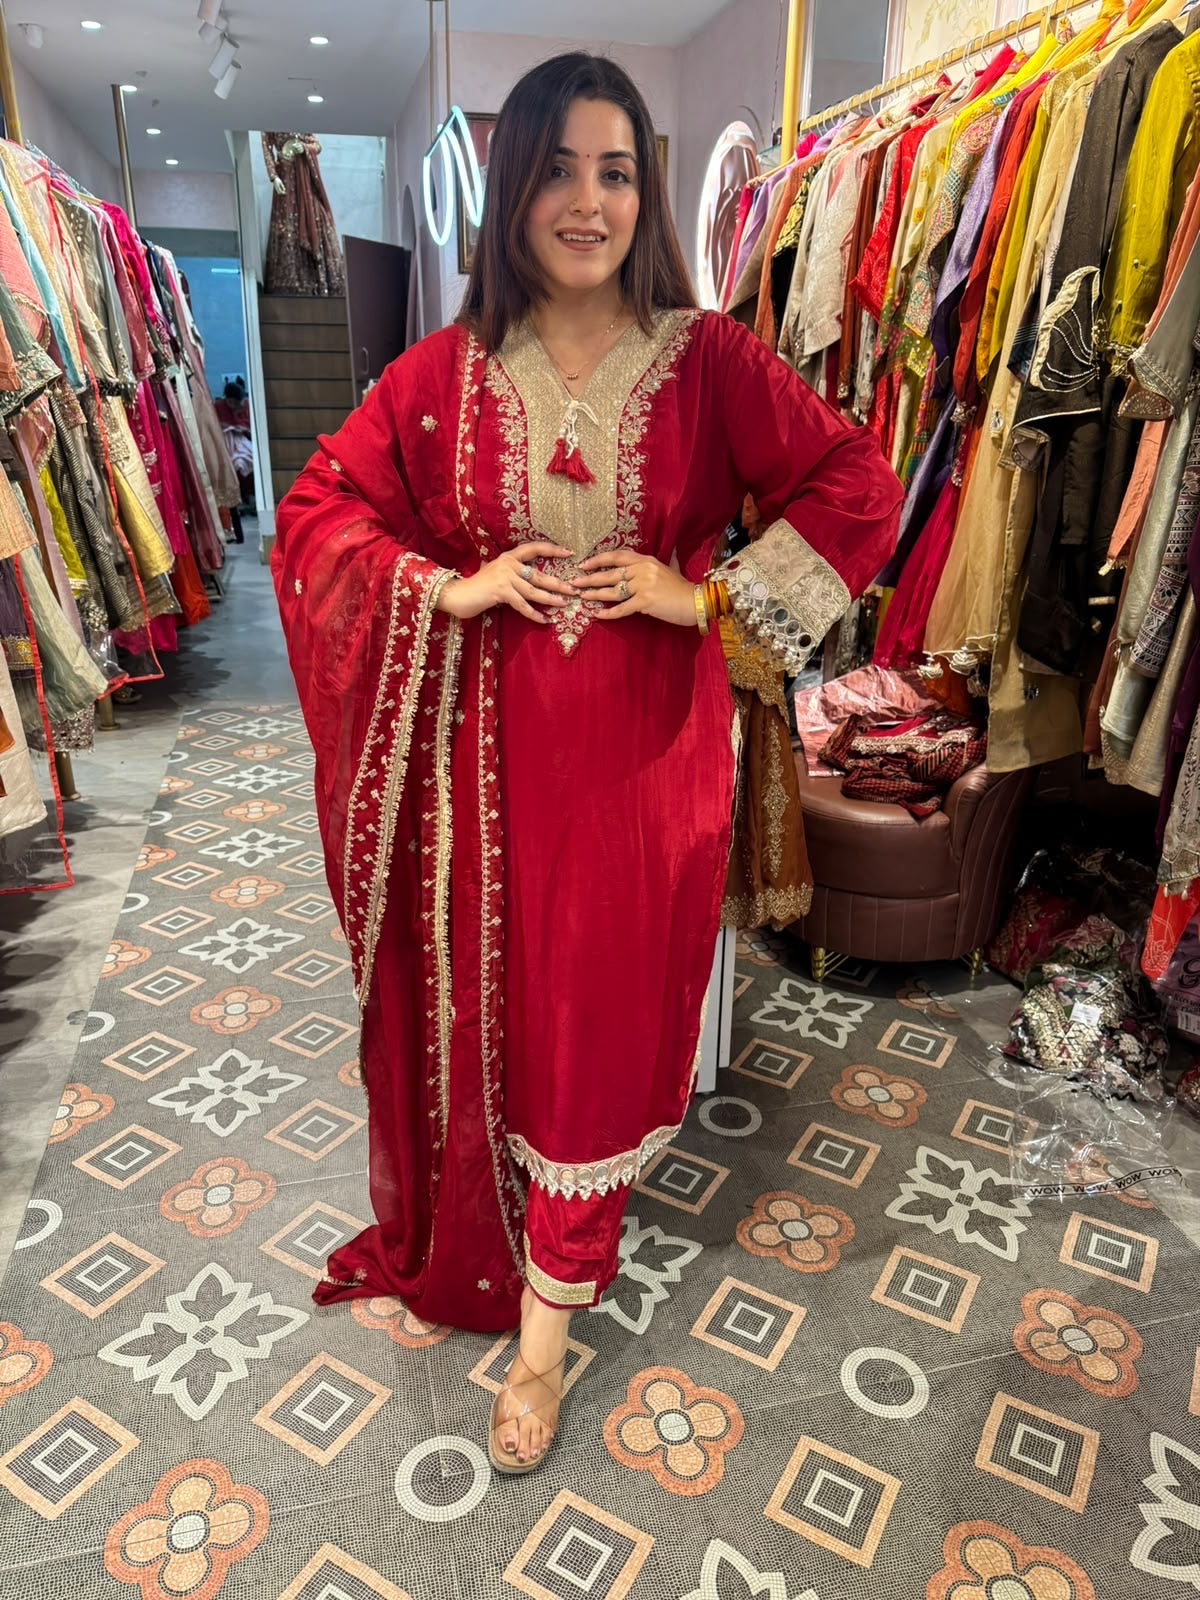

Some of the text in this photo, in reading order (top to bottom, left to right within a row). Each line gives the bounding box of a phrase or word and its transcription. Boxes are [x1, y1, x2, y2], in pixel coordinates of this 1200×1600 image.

[1030, 1187, 1066, 1195] WOW
[1073, 1184, 1108, 1193] WOW
[1116, 1173, 1142, 1188] WOW
